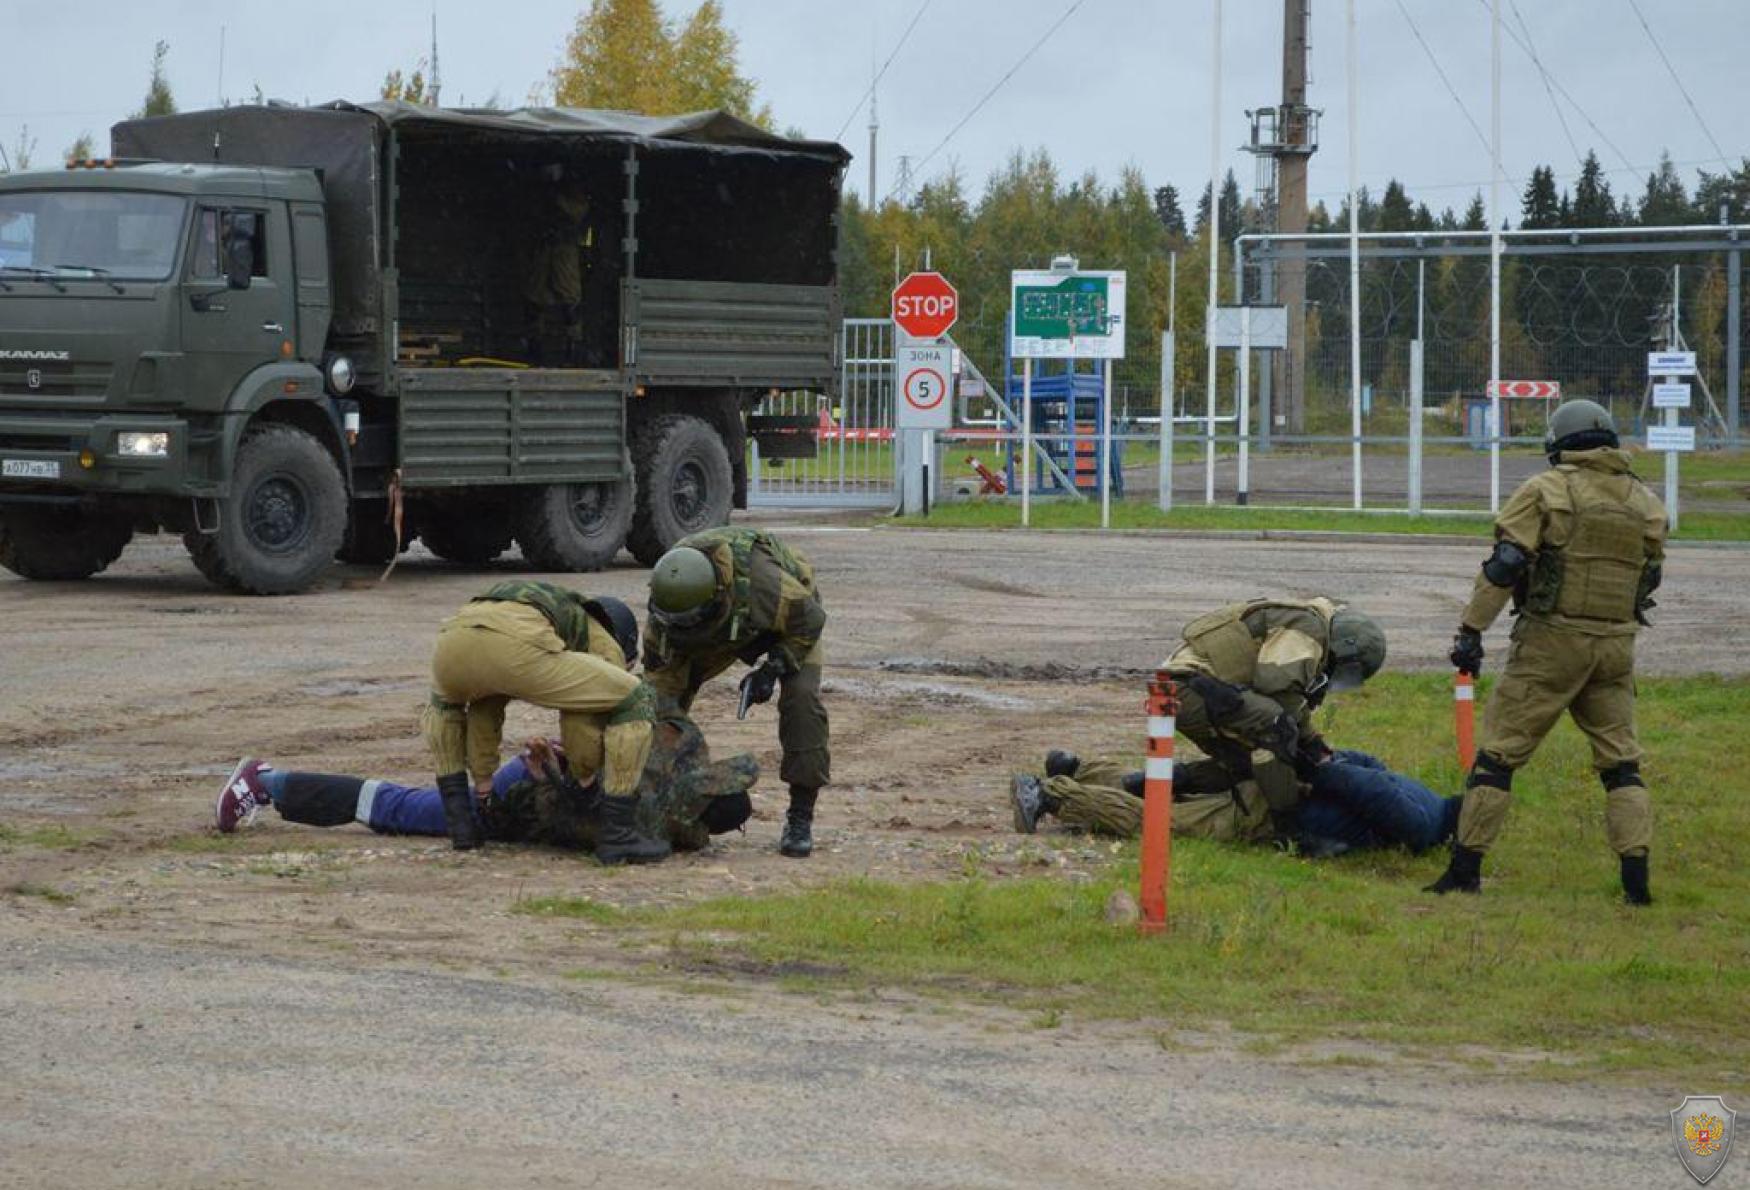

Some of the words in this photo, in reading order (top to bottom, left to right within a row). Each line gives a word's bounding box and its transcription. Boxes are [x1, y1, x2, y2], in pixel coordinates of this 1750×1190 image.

[898, 296, 954, 316] STOP
[910, 351, 941, 361] ЗОНА
[918, 381, 930, 398] 5
